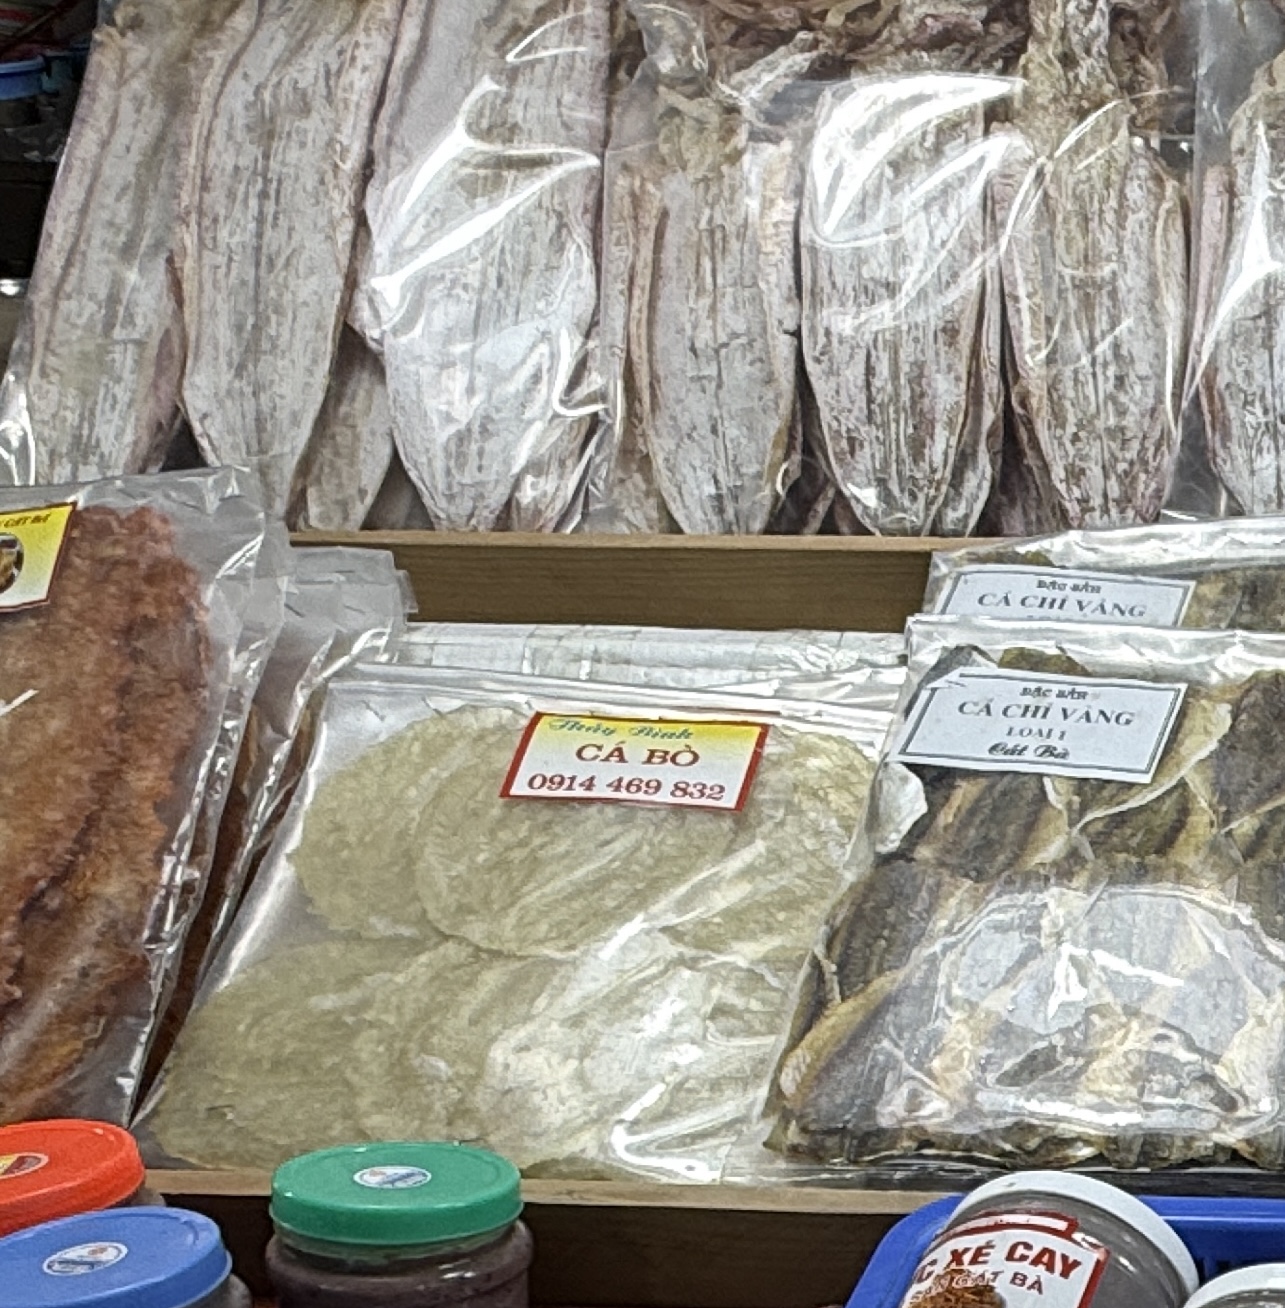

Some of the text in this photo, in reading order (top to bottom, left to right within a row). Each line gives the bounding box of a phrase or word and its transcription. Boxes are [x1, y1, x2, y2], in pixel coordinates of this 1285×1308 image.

[958, 699, 993, 717] CÁ
[1061, 706, 1135, 726] VÀNG
[576, 740, 699, 767] CÁ BÒ
[528, 773, 725, 801] 0914 469 832
[942, 1240, 1082, 1280] XÉ CAY
[1010, 1270, 1044, 1296] BÀ
